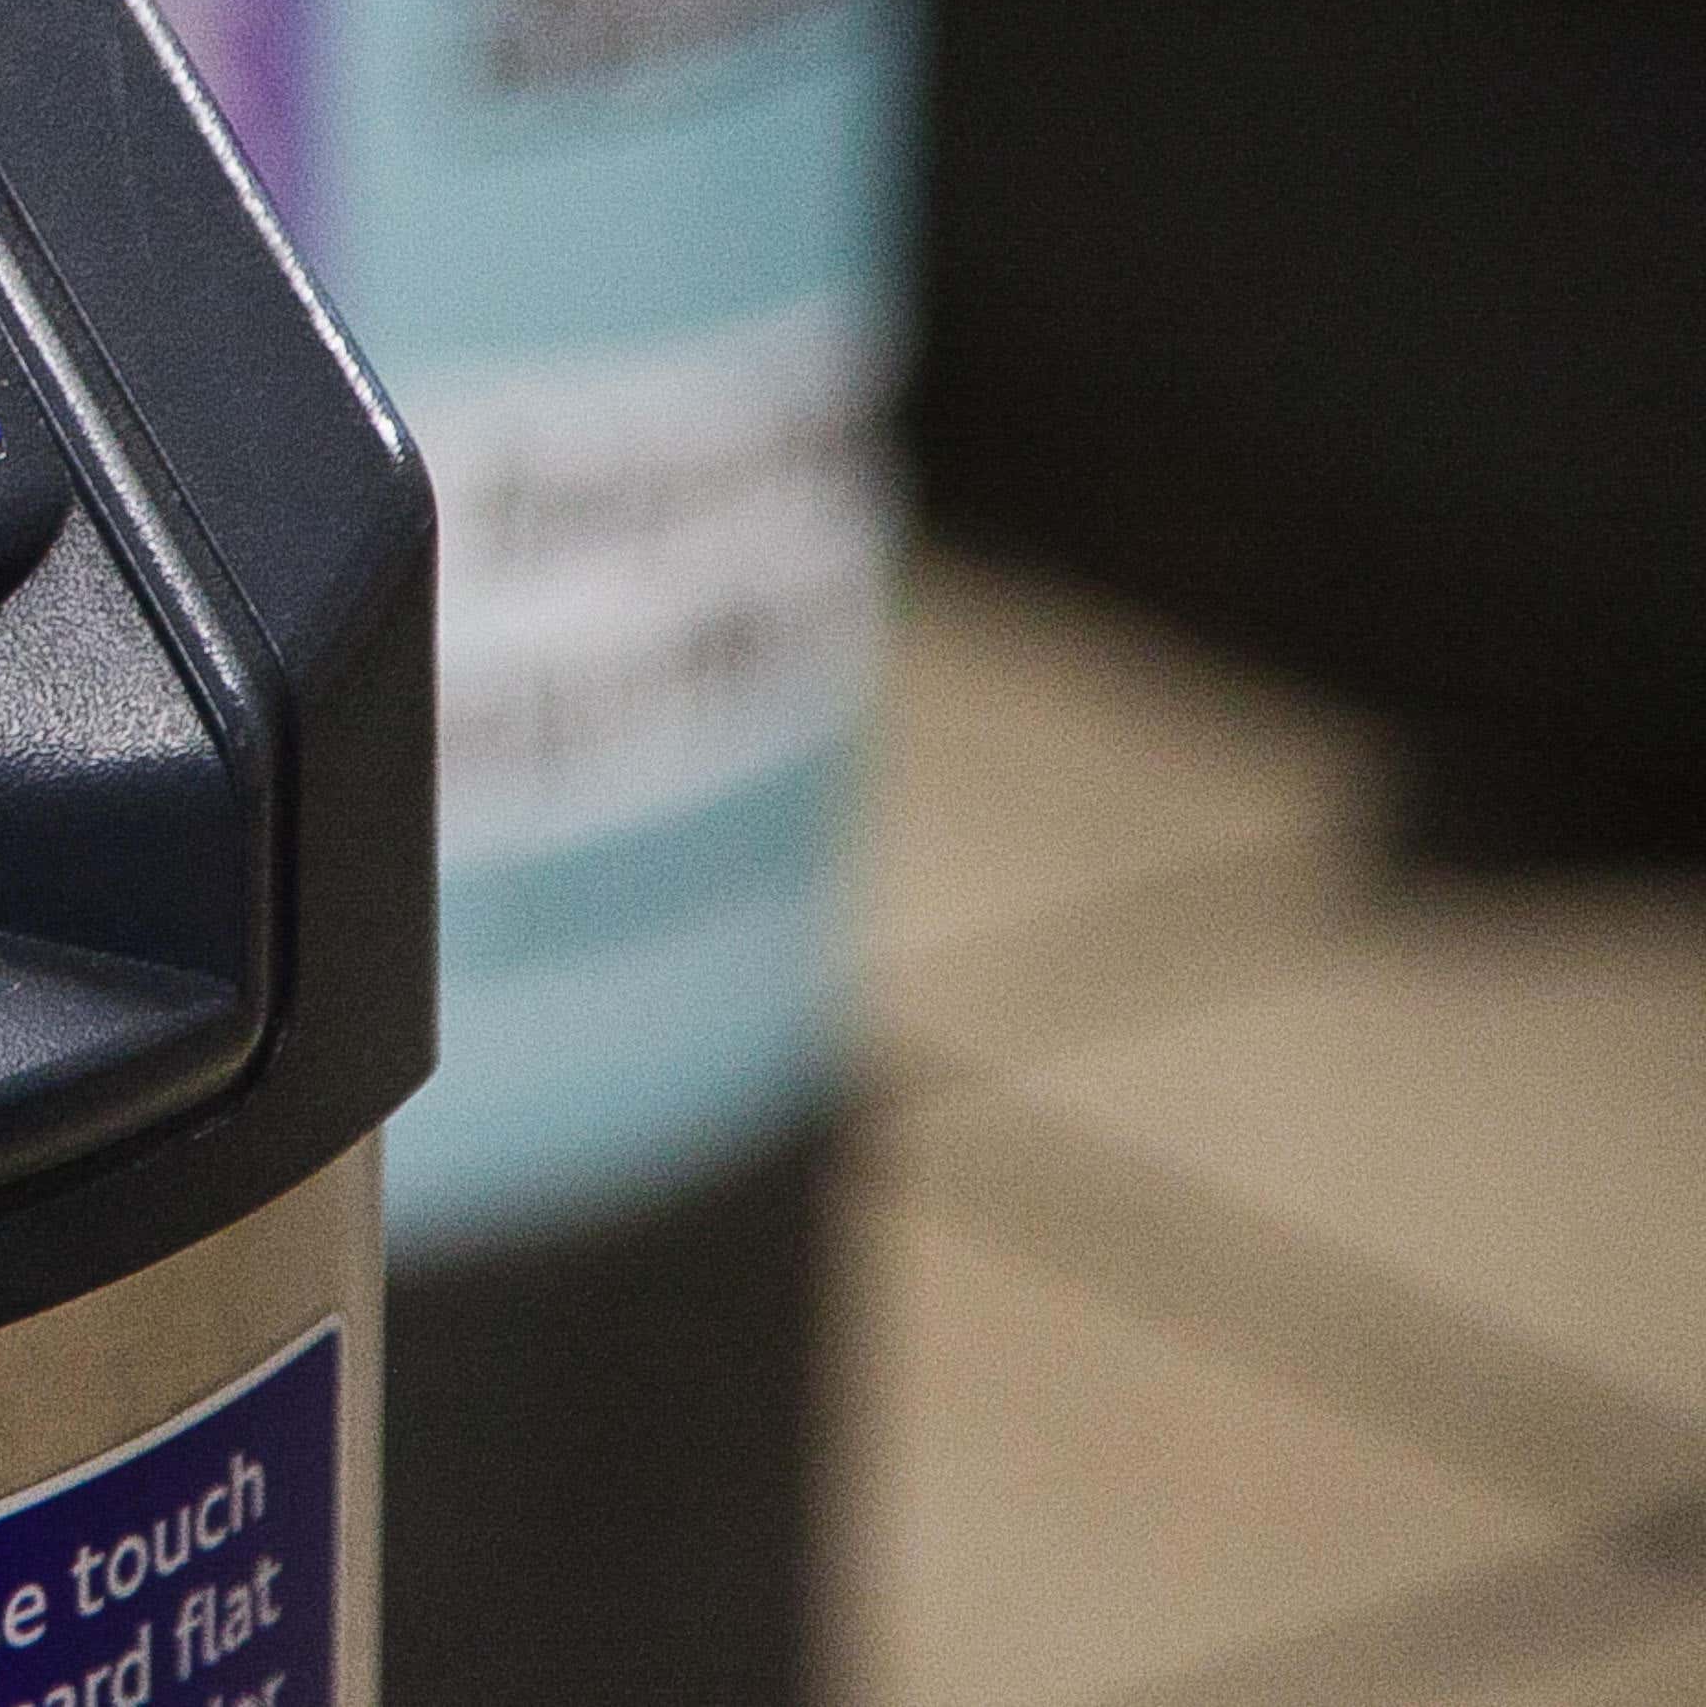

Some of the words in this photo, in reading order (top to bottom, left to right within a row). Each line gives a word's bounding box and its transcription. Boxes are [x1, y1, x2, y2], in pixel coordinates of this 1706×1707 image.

[71, 1453, 266, 1616] touch
[15, 1624, 151, 1707] rd
[176, 1558, 282, 1680] flat
